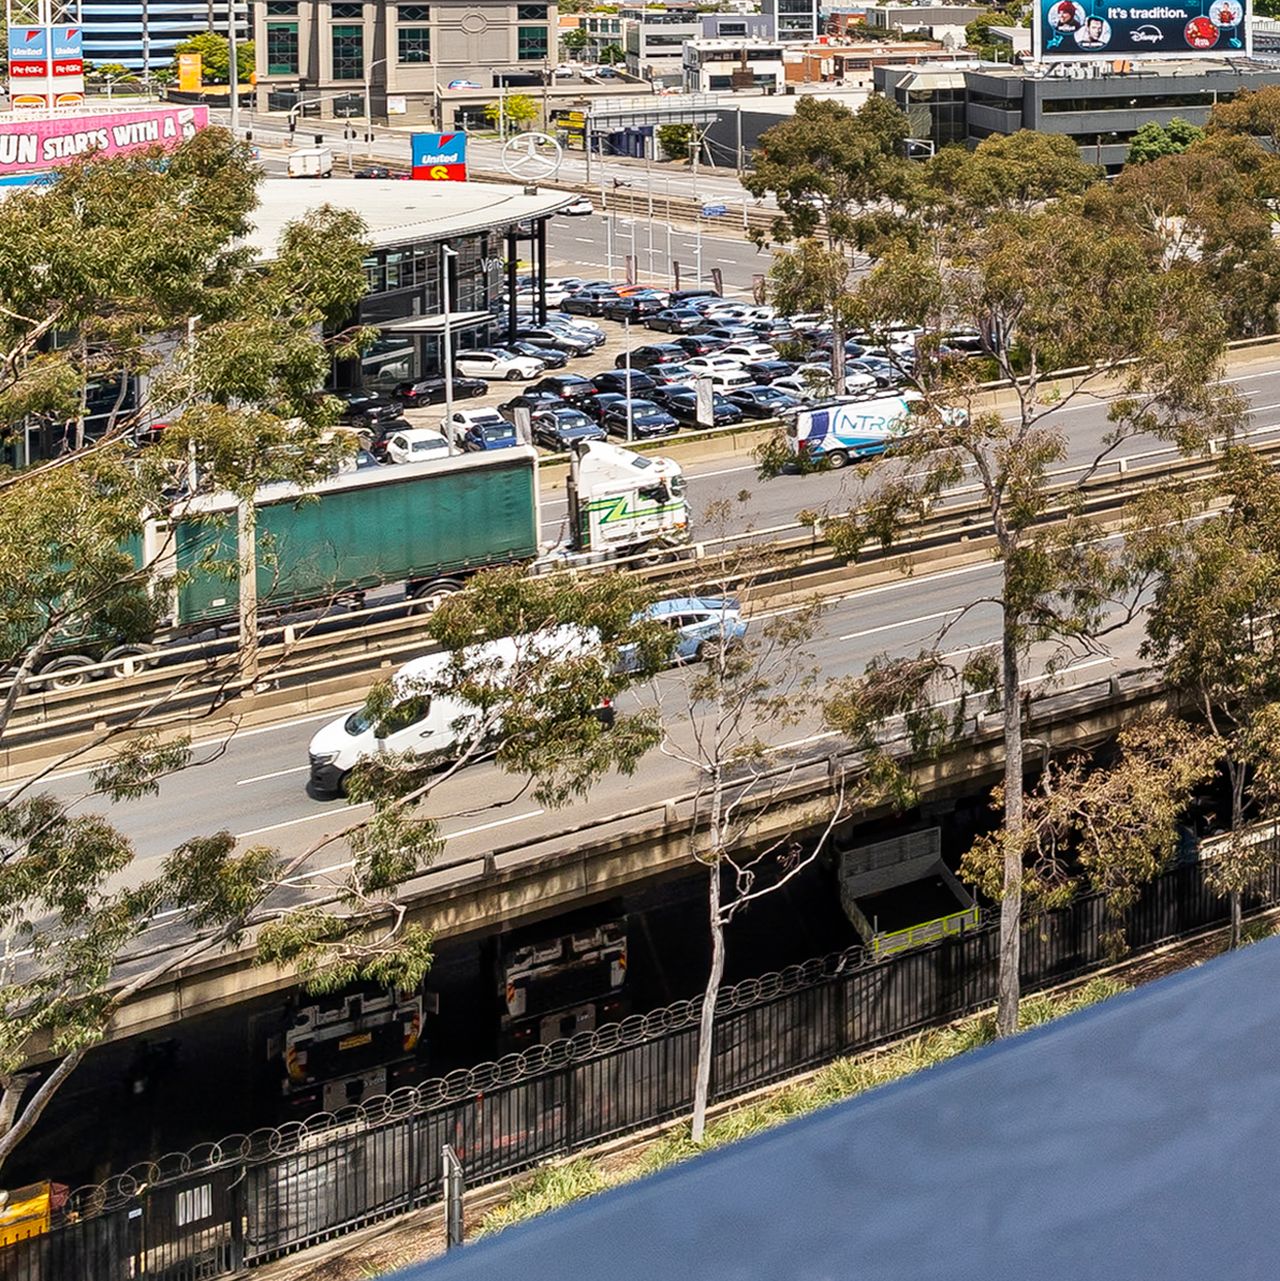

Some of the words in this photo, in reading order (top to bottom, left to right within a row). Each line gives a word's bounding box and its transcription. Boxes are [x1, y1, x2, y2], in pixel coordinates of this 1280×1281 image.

[1108, 7, 1128, 19] It's
[1129, 7, 1188, 19] tradition.
[43, 129, 109, 160] STARTS
[112, 120, 159, 147] WITH
[164, 118, 176, 136] A
[421, 152, 458, 164] United
[481, 256, 505, 273] Vans
